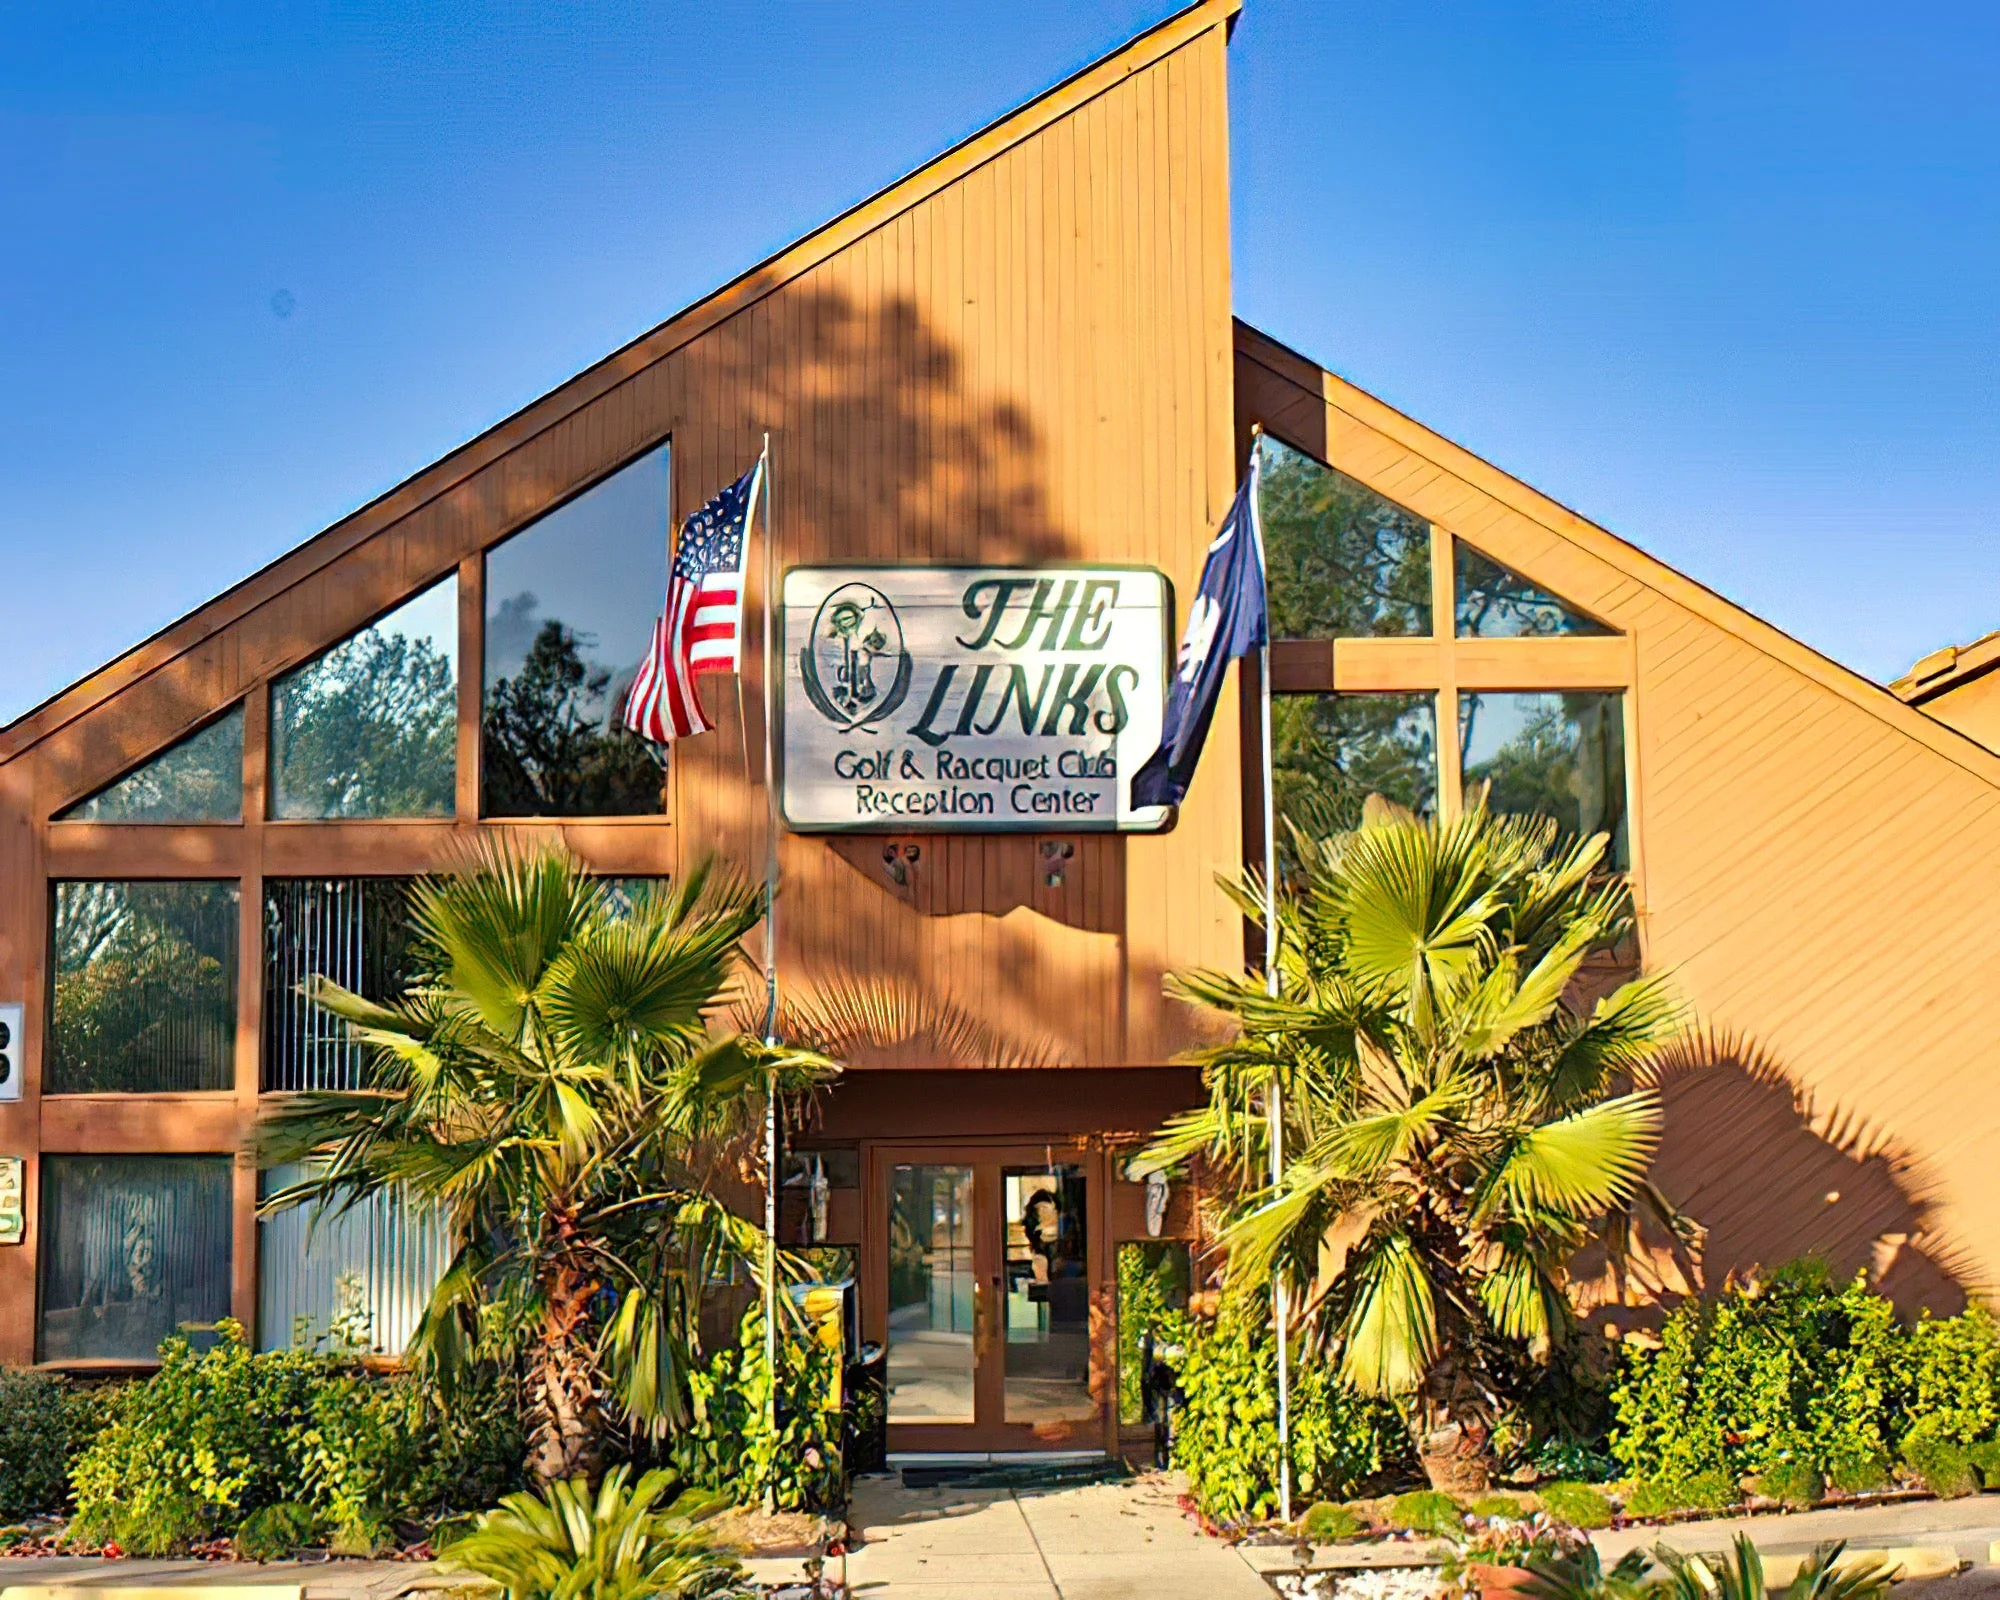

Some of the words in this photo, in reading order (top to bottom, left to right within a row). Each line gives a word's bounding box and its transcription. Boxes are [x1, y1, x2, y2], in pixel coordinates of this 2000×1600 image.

[955, 578, 1121, 652] THE
[906, 663, 1140, 747] LINKS
[834, 749, 895, 780] Golf
[900, 748, 925, 780] &
[936, 749, 1050, 783] Racquet
[856, 784, 994, 816] Reception
[1011, 783, 1101, 814] Center
